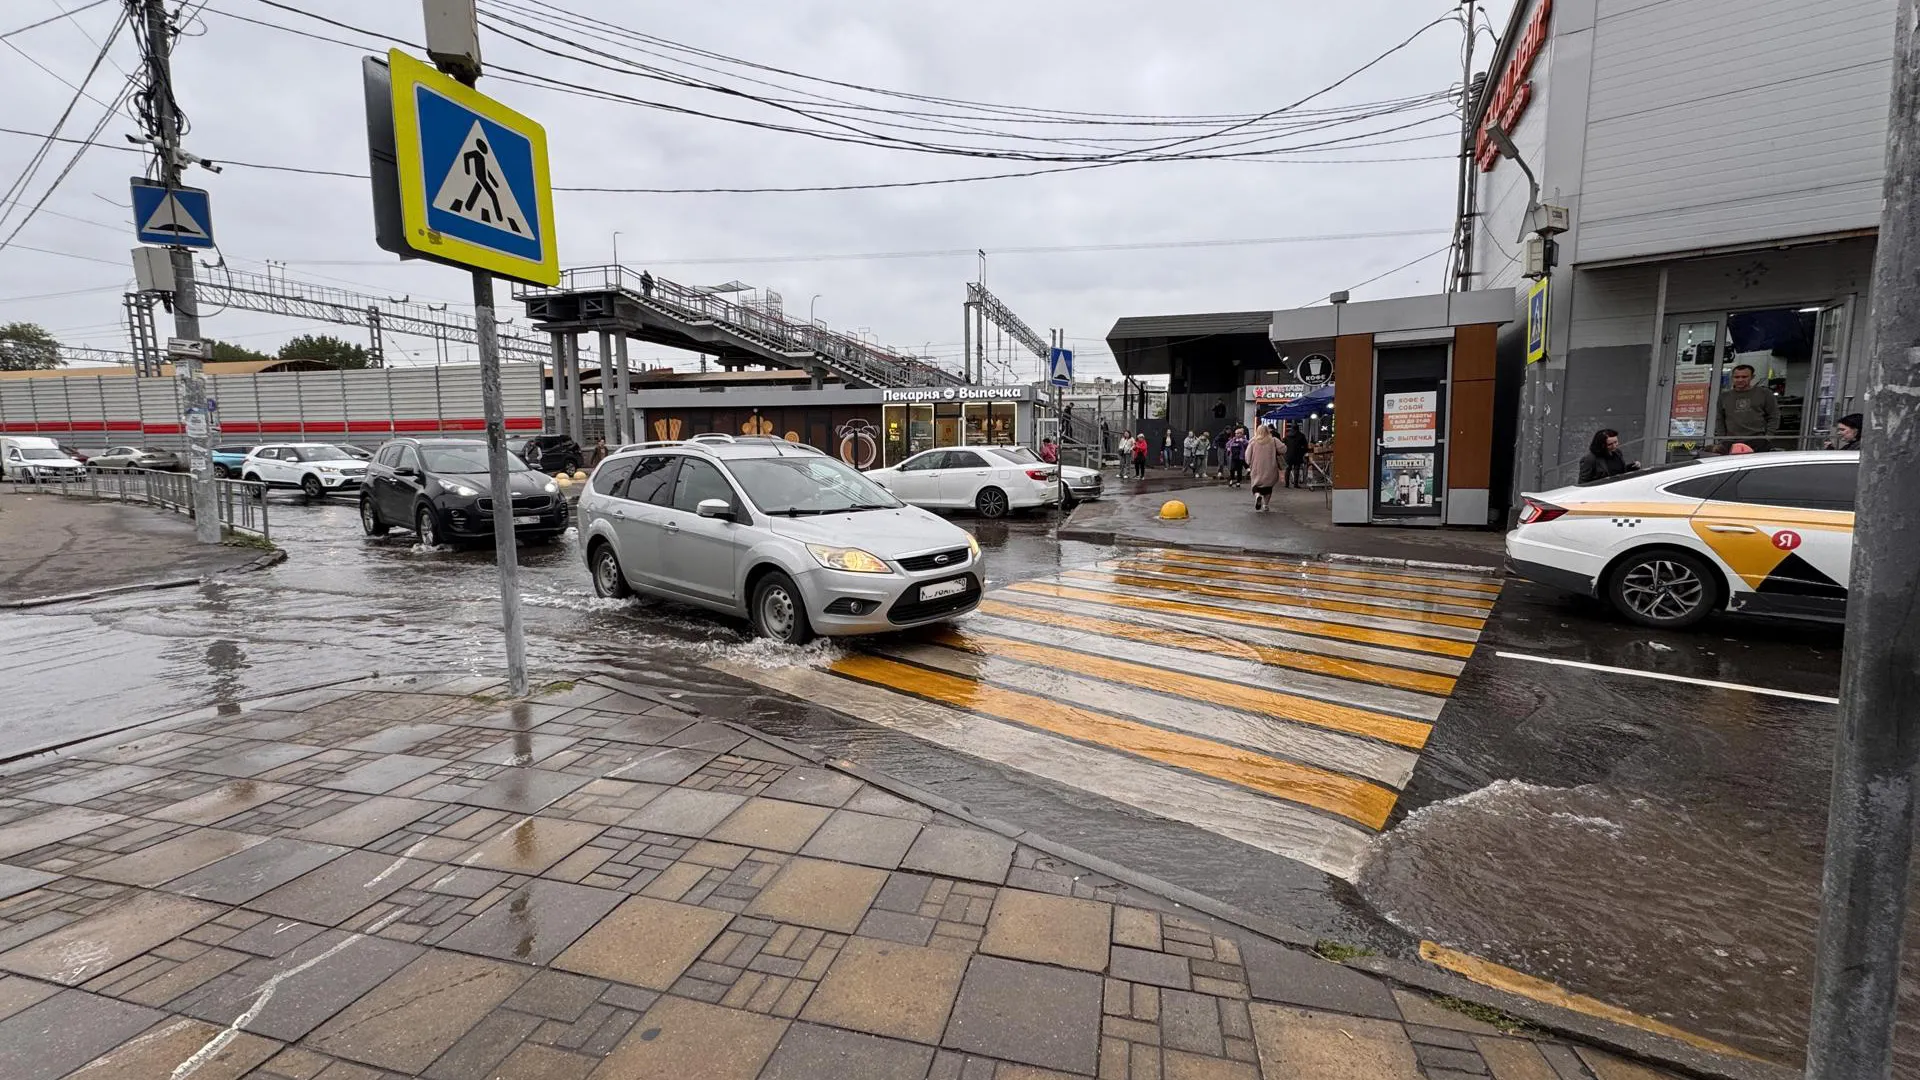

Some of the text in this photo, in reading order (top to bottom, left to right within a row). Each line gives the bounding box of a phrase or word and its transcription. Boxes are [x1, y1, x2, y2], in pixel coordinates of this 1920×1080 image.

[883, 387, 1021, 402] Пекарня Выпечка
[1778, 534, 1792, 547] Я
